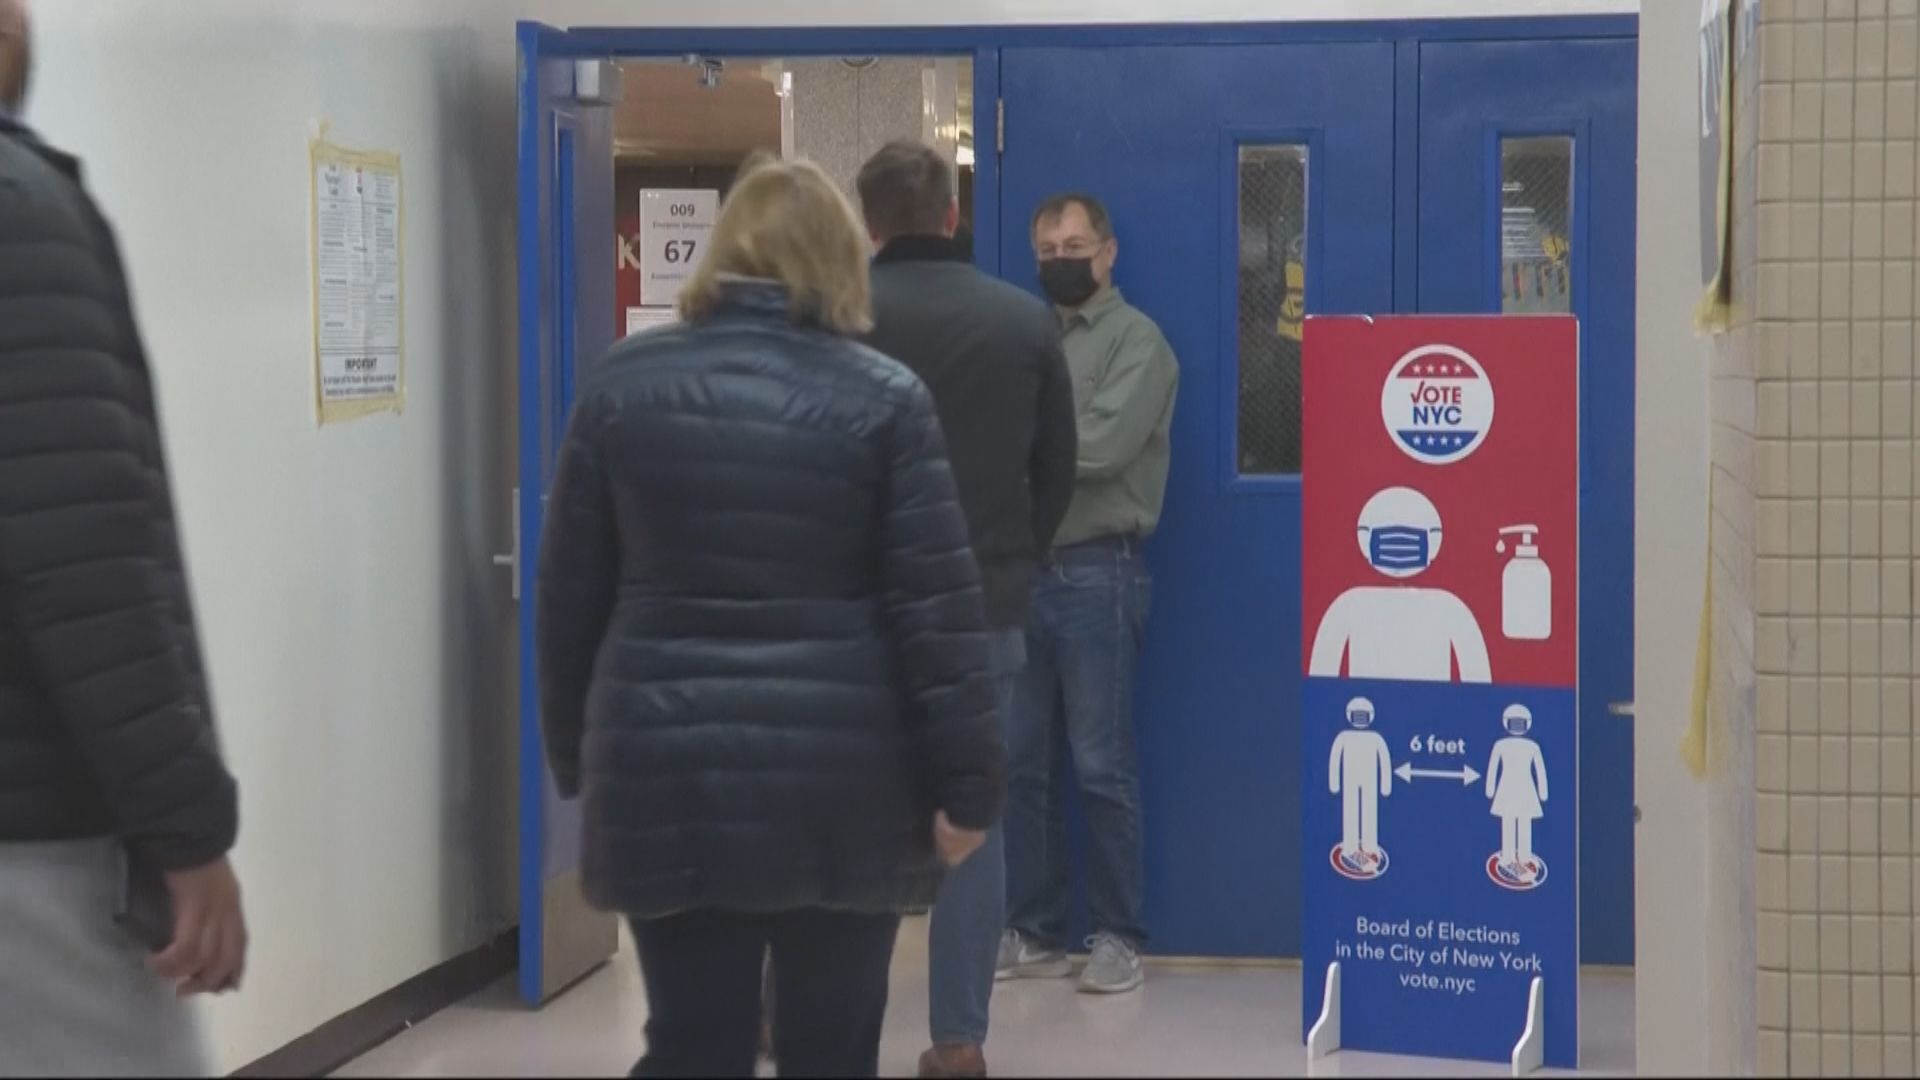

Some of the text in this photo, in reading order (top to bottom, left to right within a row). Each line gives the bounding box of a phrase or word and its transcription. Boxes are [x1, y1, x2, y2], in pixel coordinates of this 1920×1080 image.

[670, 204, 695, 217] 009
[664, 240, 696, 264] 67
[1410, 380, 1462, 404] VOTE
[1413, 406, 1462, 425] NYC
[1410, 734, 1466, 754] 6 feet
[1356, 916, 1520, 945] Board of Elections
[1335, 940, 1542, 971] in the City of New York
[1399, 973, 1476, 995] vote.nyc
